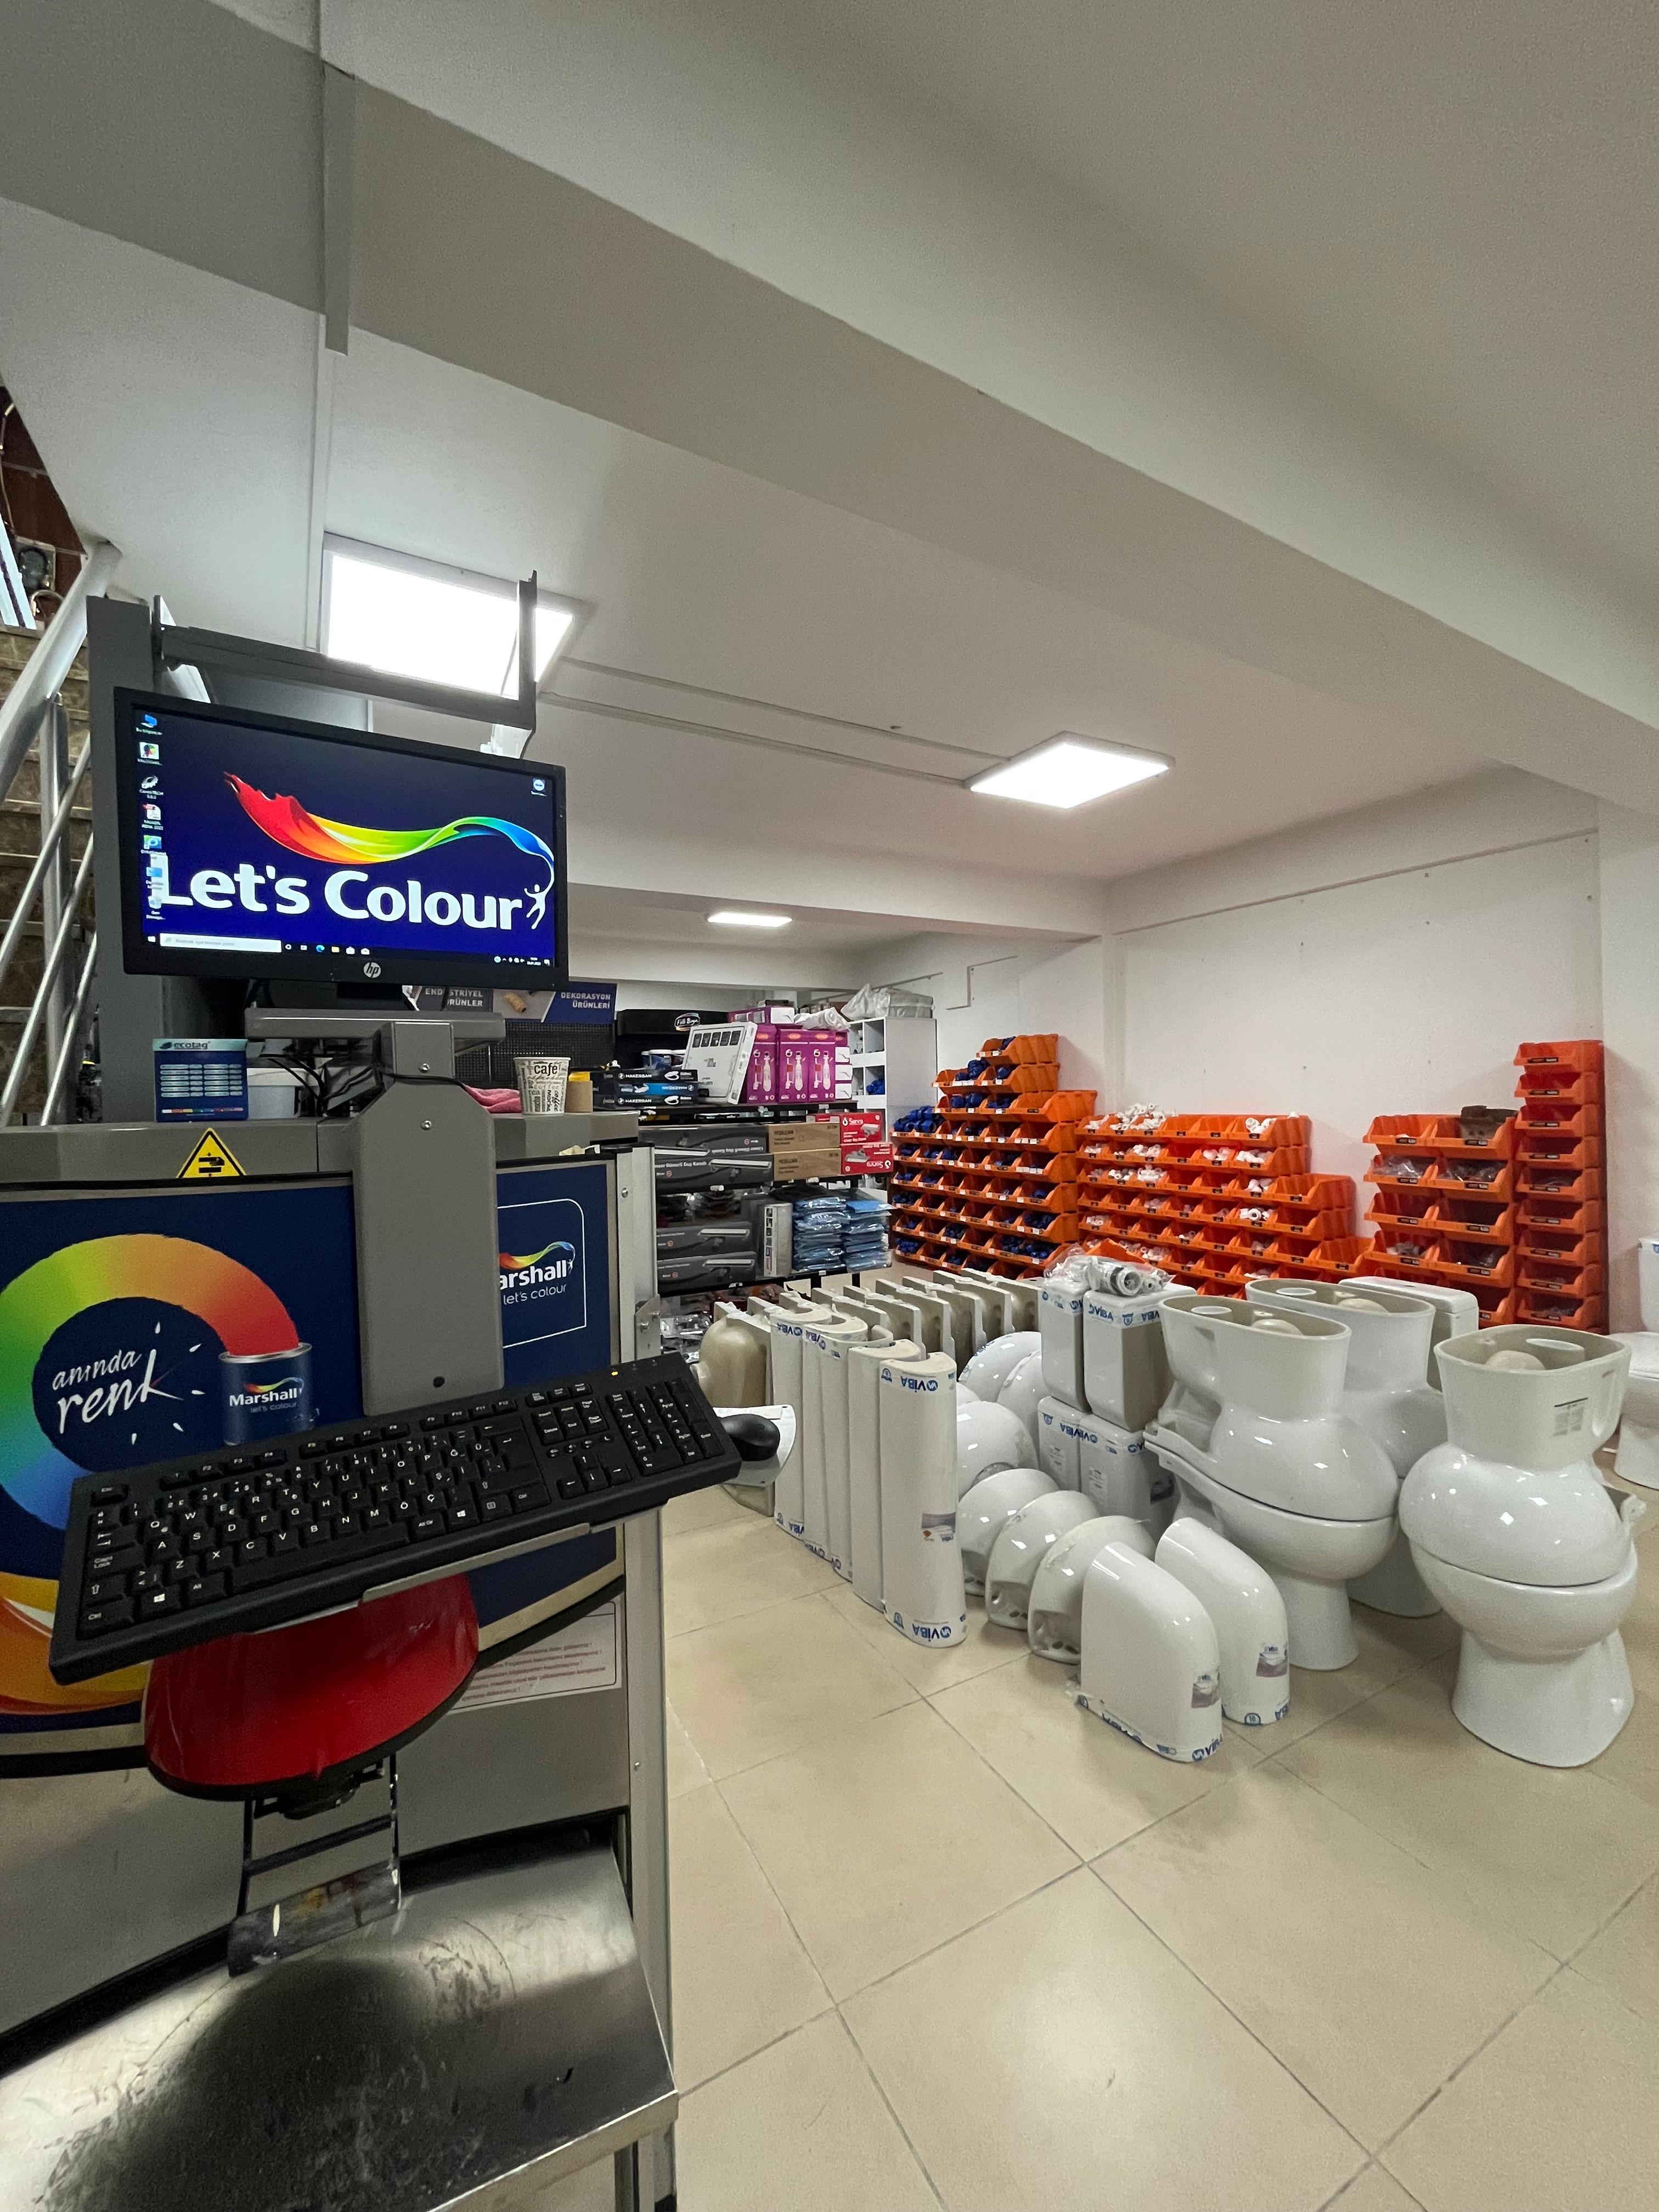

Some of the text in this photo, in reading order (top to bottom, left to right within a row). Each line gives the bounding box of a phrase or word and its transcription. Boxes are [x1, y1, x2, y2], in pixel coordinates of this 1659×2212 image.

[150, 854, 522, 930] Let's Colour
[425, 988, 483, 998] ENDSTRİYEL
[447, 998, 483, 1007] RÜNLER
[561, 991, 611, 1001] DEKORASYON
[572, 1000, 611, 1009] ÜRÜNLERİ
[500, 1260, 567, 1290] arshall
[503, 1284, 567, 1305] let's colour
[52, 1349, 143, 1391] anında
[57, 1348, 184, 1434] renk
[900, 1375, 927, 1392] VİBA
[229, 1388, 298, 1407] Marshall
[912, 1623, 940, 1642] VİBA
